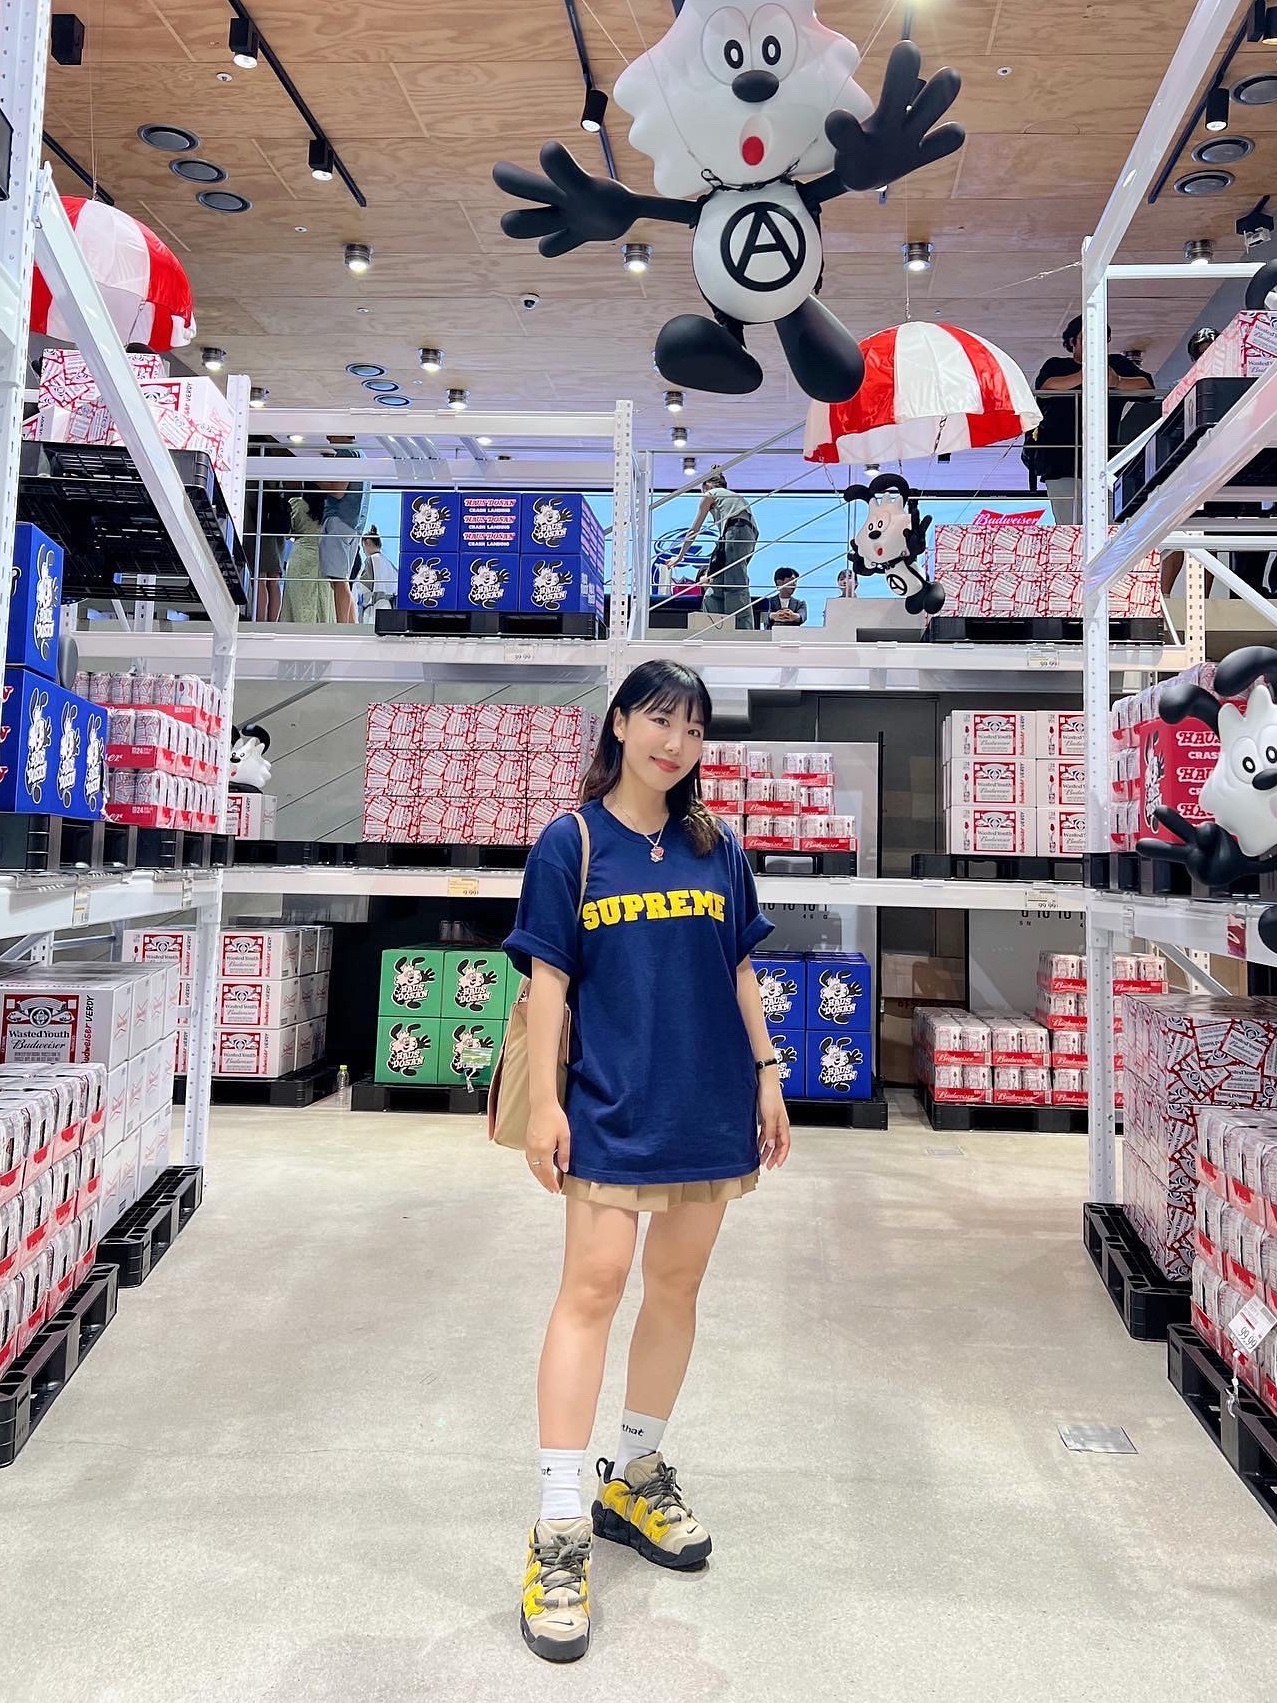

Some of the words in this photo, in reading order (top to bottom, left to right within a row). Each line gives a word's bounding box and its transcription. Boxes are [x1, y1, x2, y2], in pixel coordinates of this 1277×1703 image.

[975, 513, 1040, 526] Budweiser
[582, 890, 726, 930] SUPREME
[86, 995, 95, 1021] VERDY
[11, 1039, 66, 1050] Budweiser
[81, 1022, 92, 1064] udweiser
[622, 1424, 644, 1436] that
